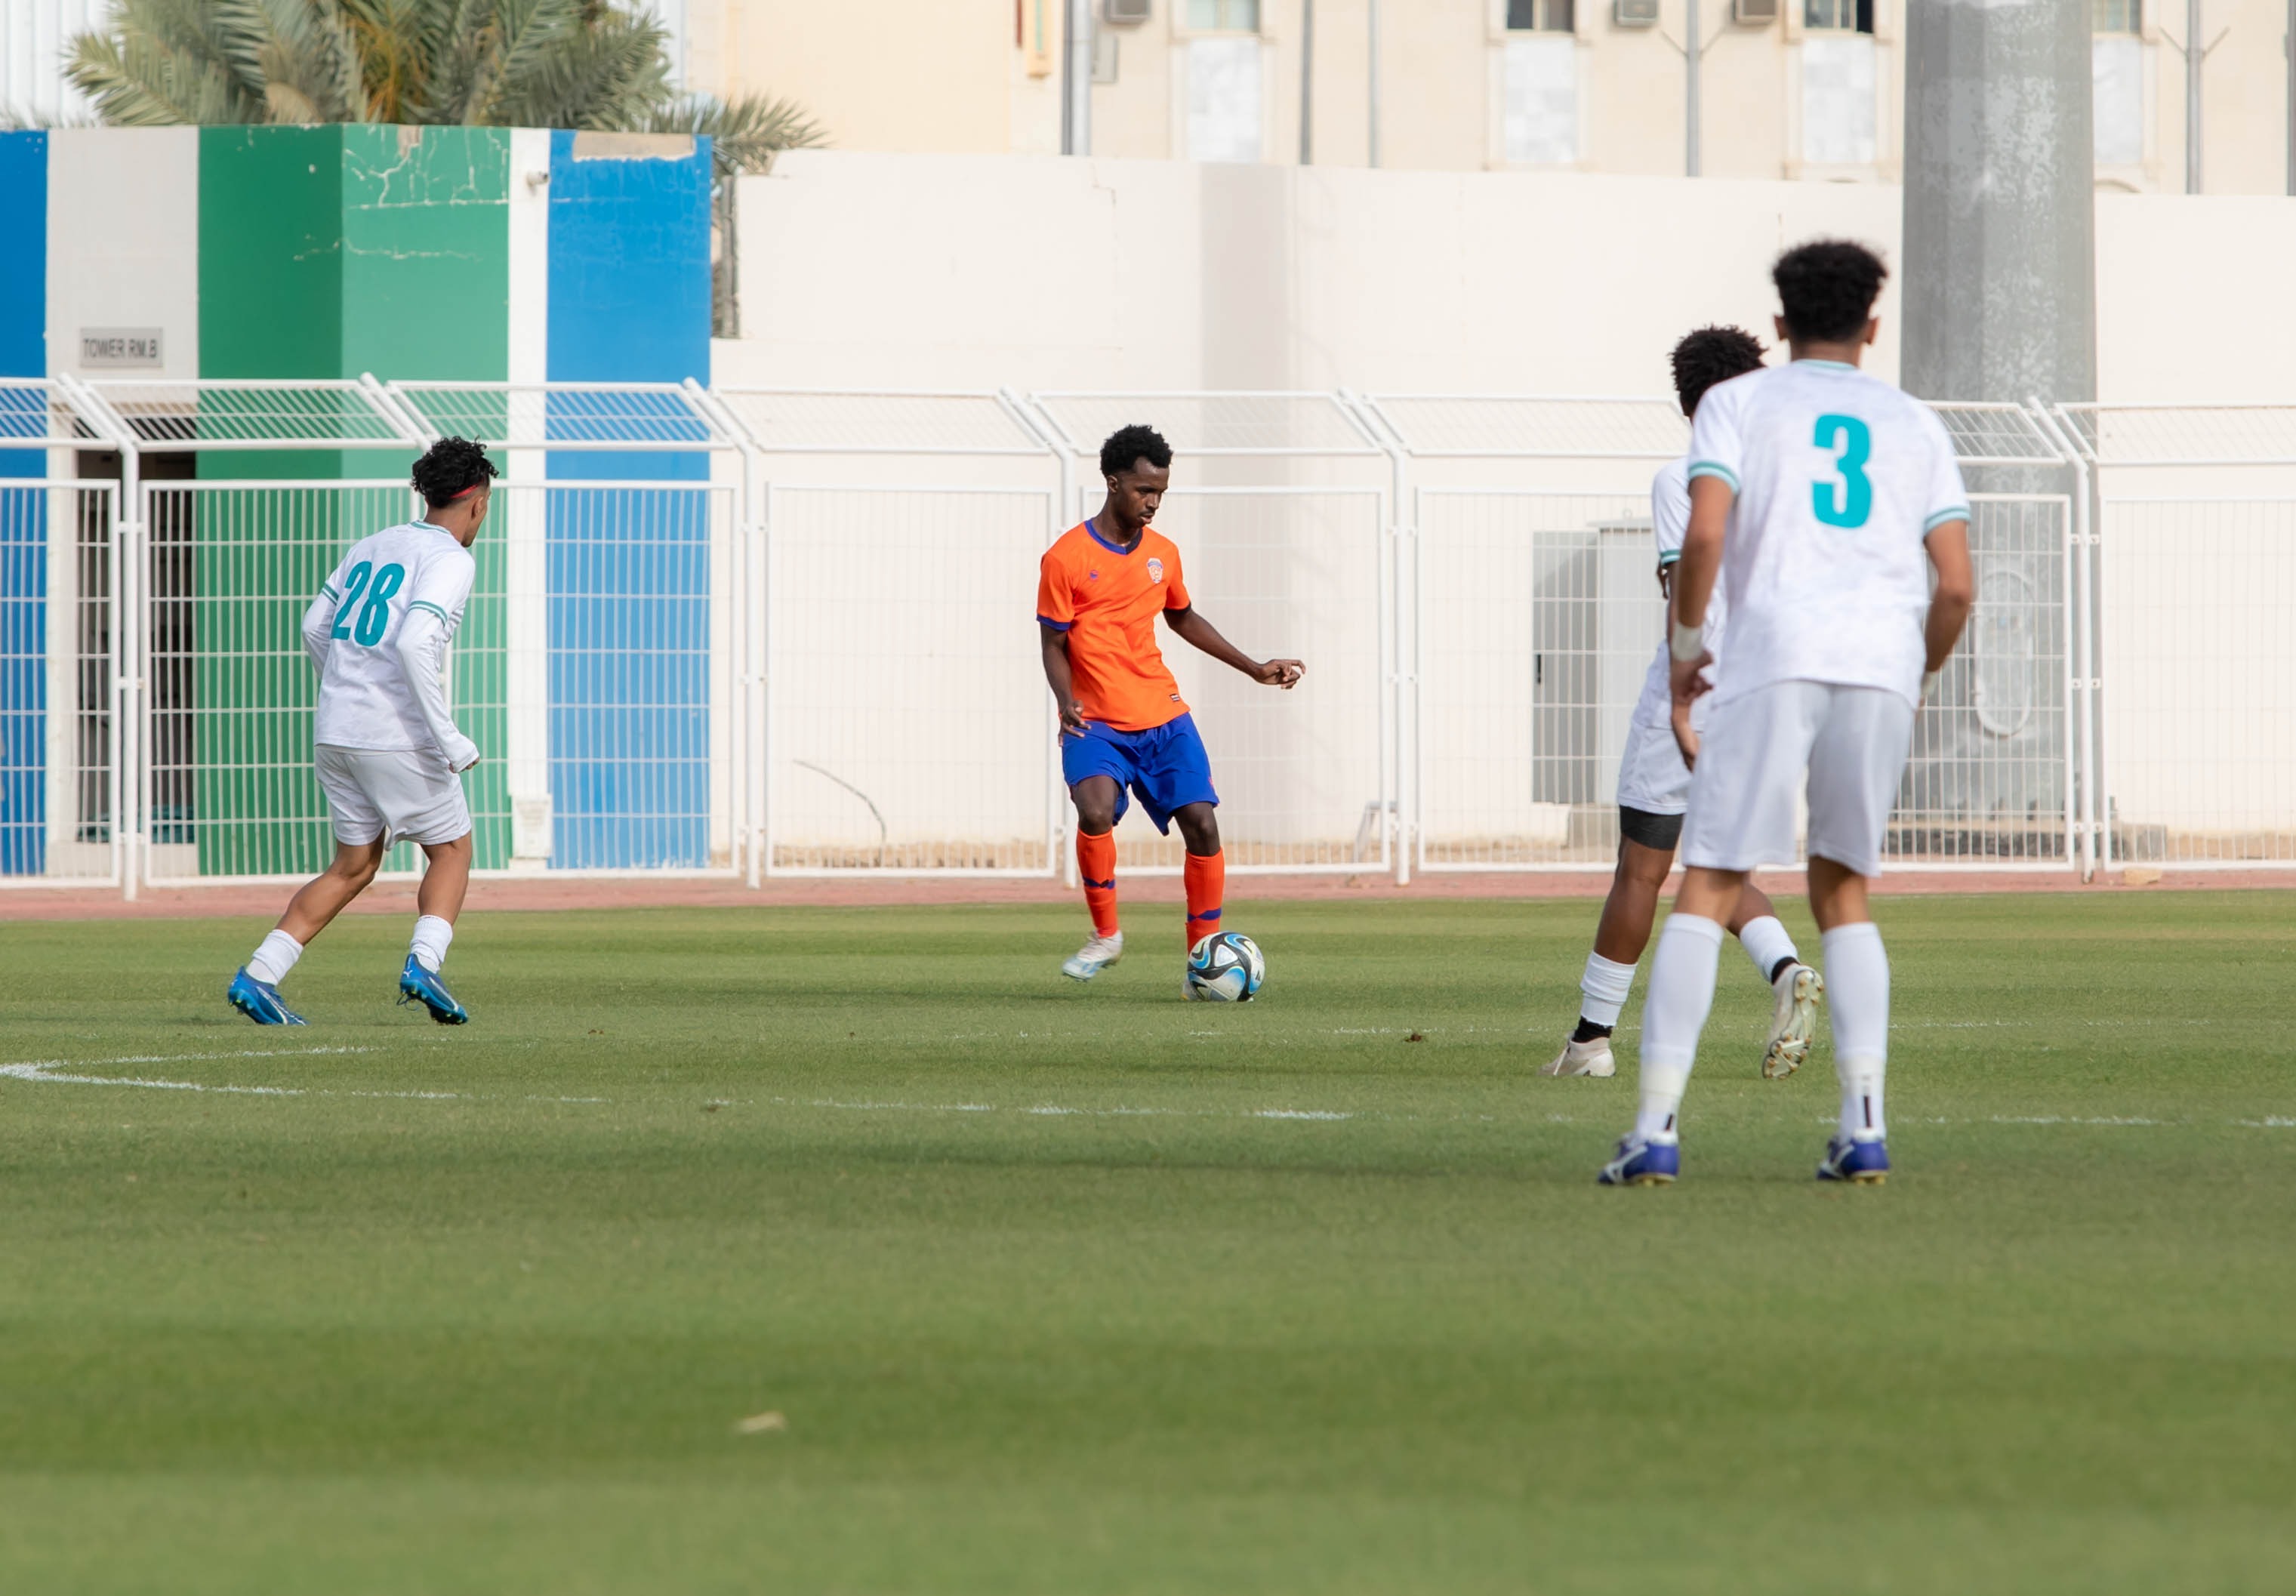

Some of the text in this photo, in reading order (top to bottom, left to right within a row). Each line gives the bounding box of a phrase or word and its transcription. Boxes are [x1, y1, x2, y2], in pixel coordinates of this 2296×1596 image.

[83, 338, 125, 358] TOWER
[1812, 414, 1872, 528] 3
[331, 560, 405, 647] 28
